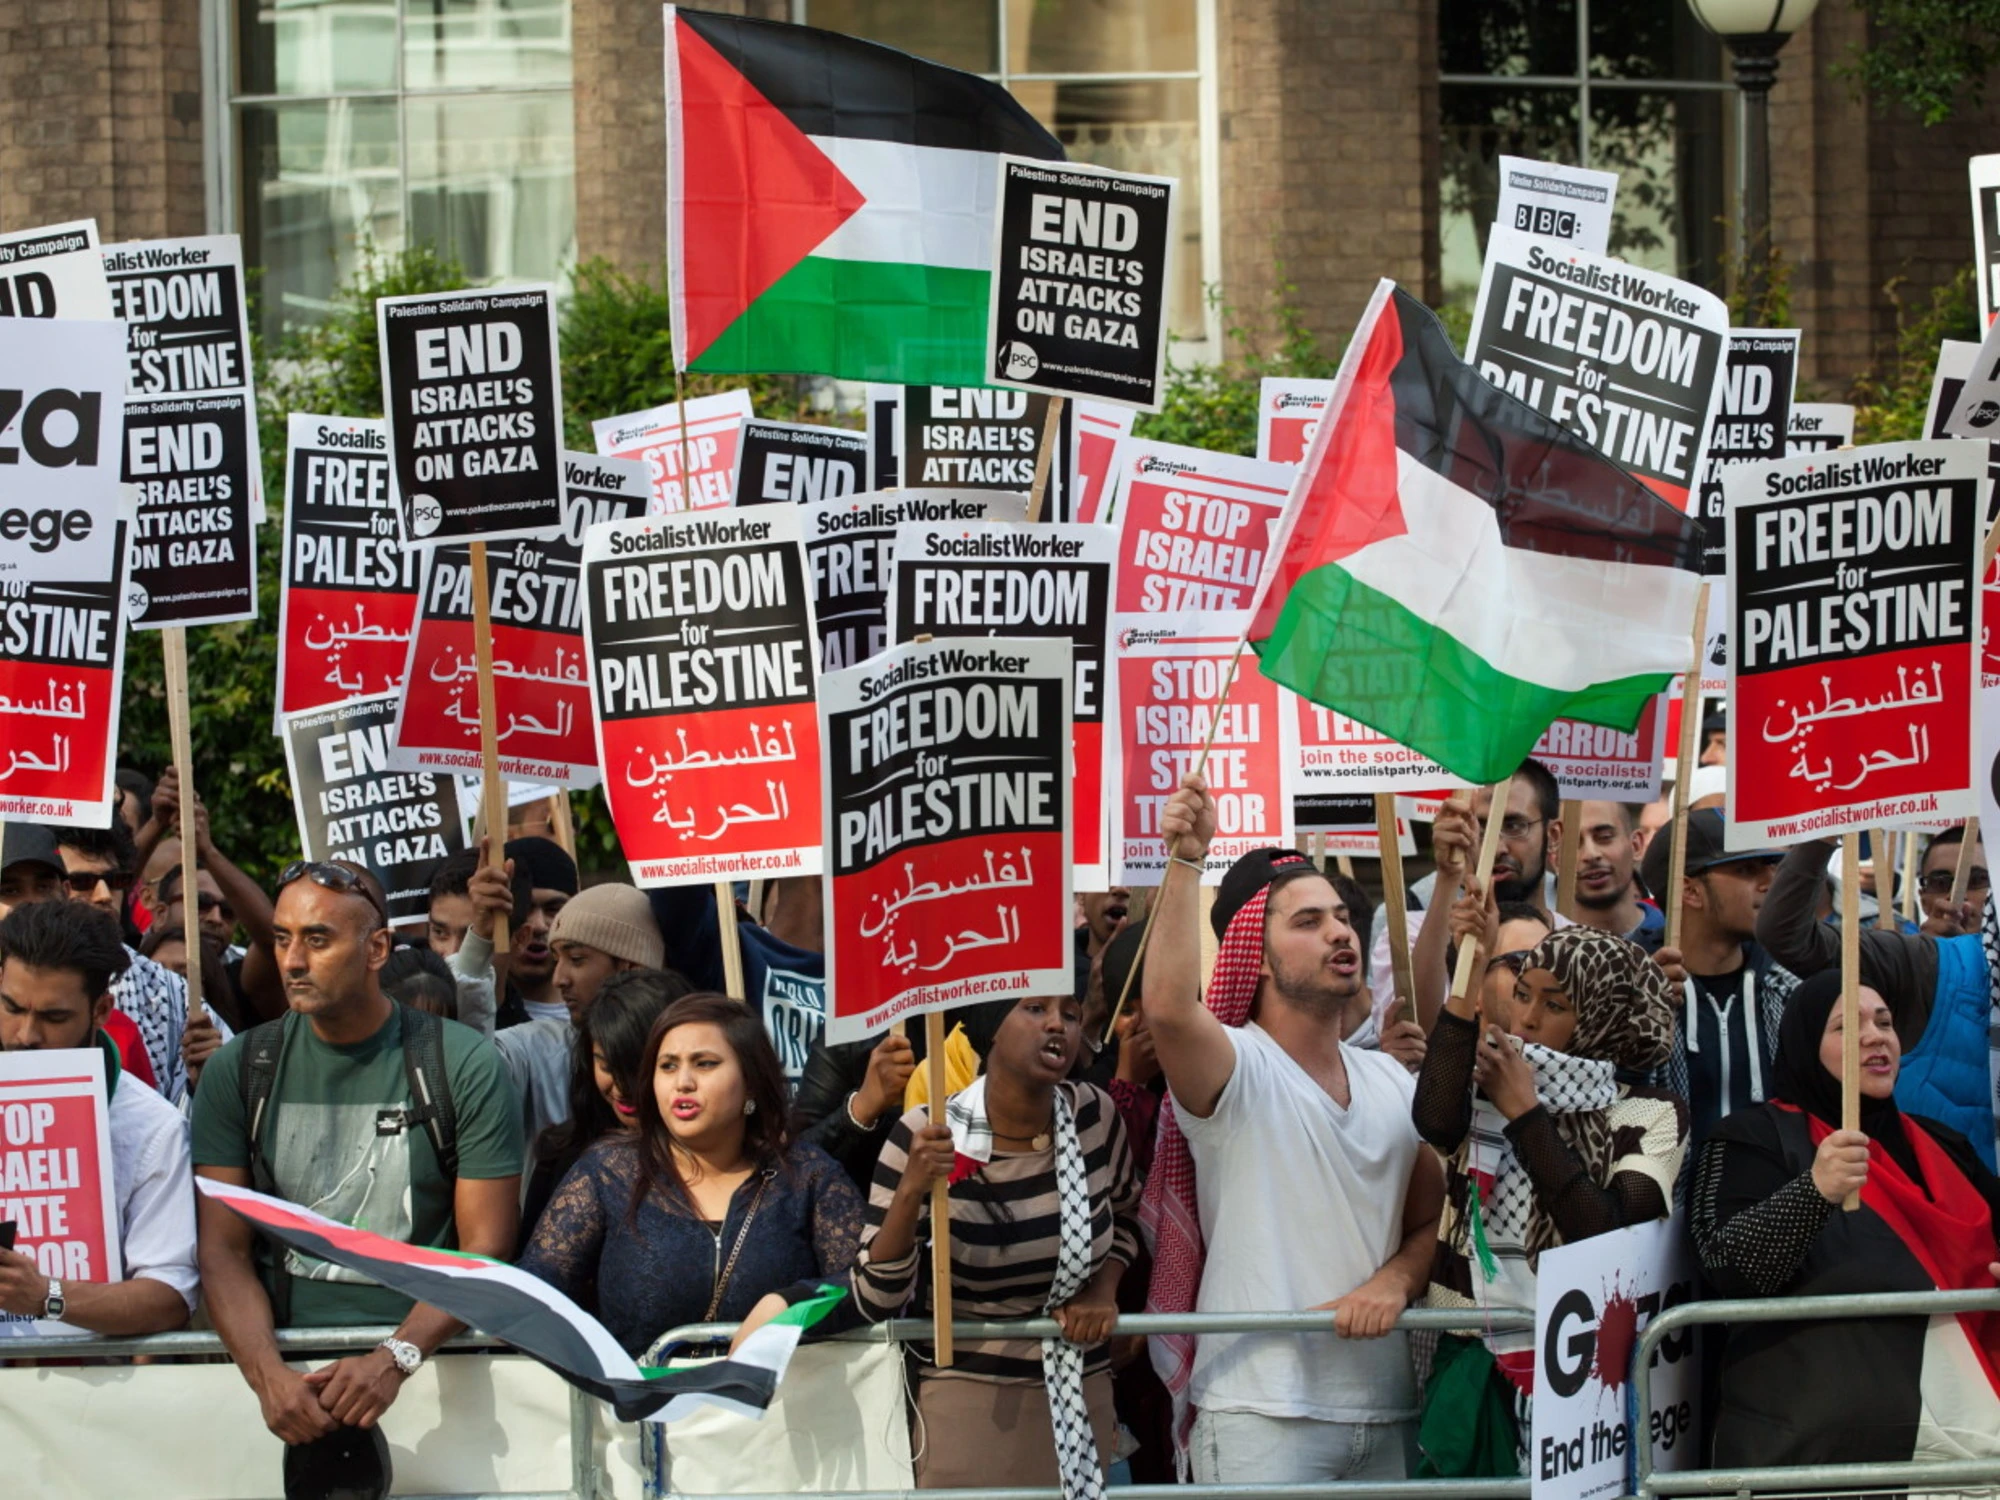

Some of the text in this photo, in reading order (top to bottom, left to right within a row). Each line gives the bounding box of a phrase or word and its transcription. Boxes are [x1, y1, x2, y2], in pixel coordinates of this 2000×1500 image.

[1010, 166, 1166, 199] Palestine Solidarity Campaign
[1030, 193, 1139, 252] END
[18, 235, 84, 256] Campaign
[146, 248, 210, 268] Worker
[1020, 246, 1144, 286] ISRAEL'S
[1527, 246, 1700, 320] Socialist Worker
[107, 272, 222, 323] EEDOM
[390, 294, 544, 318] Palestine Solidarity Campaign
[1018, 277, 1142, 318] ATTACKS
[132, 326, 157, 348] for
[1016, 308, 1140, 350] ON GAZA
[1502, 276, 1702, 388] FREEDOM
[1752, 340, 1794, 353] Campaign
[415, 322, 523, 380] END
[1012, 352, 1036, 369] PSC
[1042, 362, 1152, 388] www.palestinecampaign.org
[1575, 360, 1606, 392] for
[1720, 365, 1773, 416] ND
[196, 396, 242, 412] Campaign
[410, 378, 534, 416] ISRAEL'S
[128, 422, 223, 475] END
[318, 426, 386, 450] Socialis
[413, 412, 536, 450] ATTACKS
[748, 428, 790, 443] Palestine
[791, 432, 834, 448] Solidarity
[922, 424, 1034, 452] ISRAEL'S
[306, 456, 397, 510] FREE
[414, 446, 538, 482] ON GAZA
[922, 456, 1035, 484] ATTACKS
[1766, 462, 1862, 498] Socialist
[1863, 453, 1946, 481] Worker
[137, 474, 232, 506] SRAEL'S
[446, 498, 556, 517] www.palestinecampaign.org
[0, 508, 92, 553] ege
[370, 511, 397, 536] for
[414, 506, 440, 521] PSC
[818, 498, 987, 534] Socialist Worker
[1162, 491, 1250, 540] STOP
[1756, 487, 1953, 572] FREEDOM
[168, 538, 234, 567] GAZA
[514, 542, 544, 569] for
[610, 518, 771, 554] Socialist Worker
[926, 532, 1084, 558] Socialist Worker
[1134, 528, 1262, 587] ISRAELI
[1836, 562, 1868, 590] for
[602, 550, 787, 623] FREEDOM
[914, 569, 1089, 626] FREEDOM
[0, 601, 111, 662] STINE
[680, 619, 710, 646] for
[1744, 580, 1964, 668] PALESTINE
[600, 640, 808, 714] PALESTINE
[859, 649, 1030, 702] Socialist Worker
[1152, 660, 1240, 700] STOP
[292, 712, 336, 731] Palestine
[338, 702, 384, 721] Solidarity
[1762, 660, 1944, 742] لفلسطين
[850, 683, 1038, 776] FREEDOM
[1136, 704, 1260, 744] ISRAELI
[318, 724, 394, 784] EN
[626, 719, 796, 787] لفلسطين
[916, 750, 948, 778] for
[1300, 749, 1332, 768] join
[1339, 750, 1368, 764] the
[1564, 762, 1652, 778] socialists!
[1789, 722, 1930, 793] الحرية
[319, 772, 437, 816] ISRAEL'S
[652, 778, 790, 841] الحرية
[326, 802, 442, 847] ATTACKS
[840, 772, 1054, 868] PALESTINE
[1767, 794, 1938, 838] www.socialistworker.co.uk
[374, 834, 448, 868] GAZA
[640, 850, 802, 880] www.socialistworker.co.uk
[1122, 842, 1153, 860] join
[860, 846, 1034, 938] لفلسطين
[882, 904, 1020, 976] الحرية
[865, 972, 1030, 1030] www.socialistworker.co.uk
[1540, 1426, 1585, 1481] End
[1592, 1420, 1626, 1464] the
